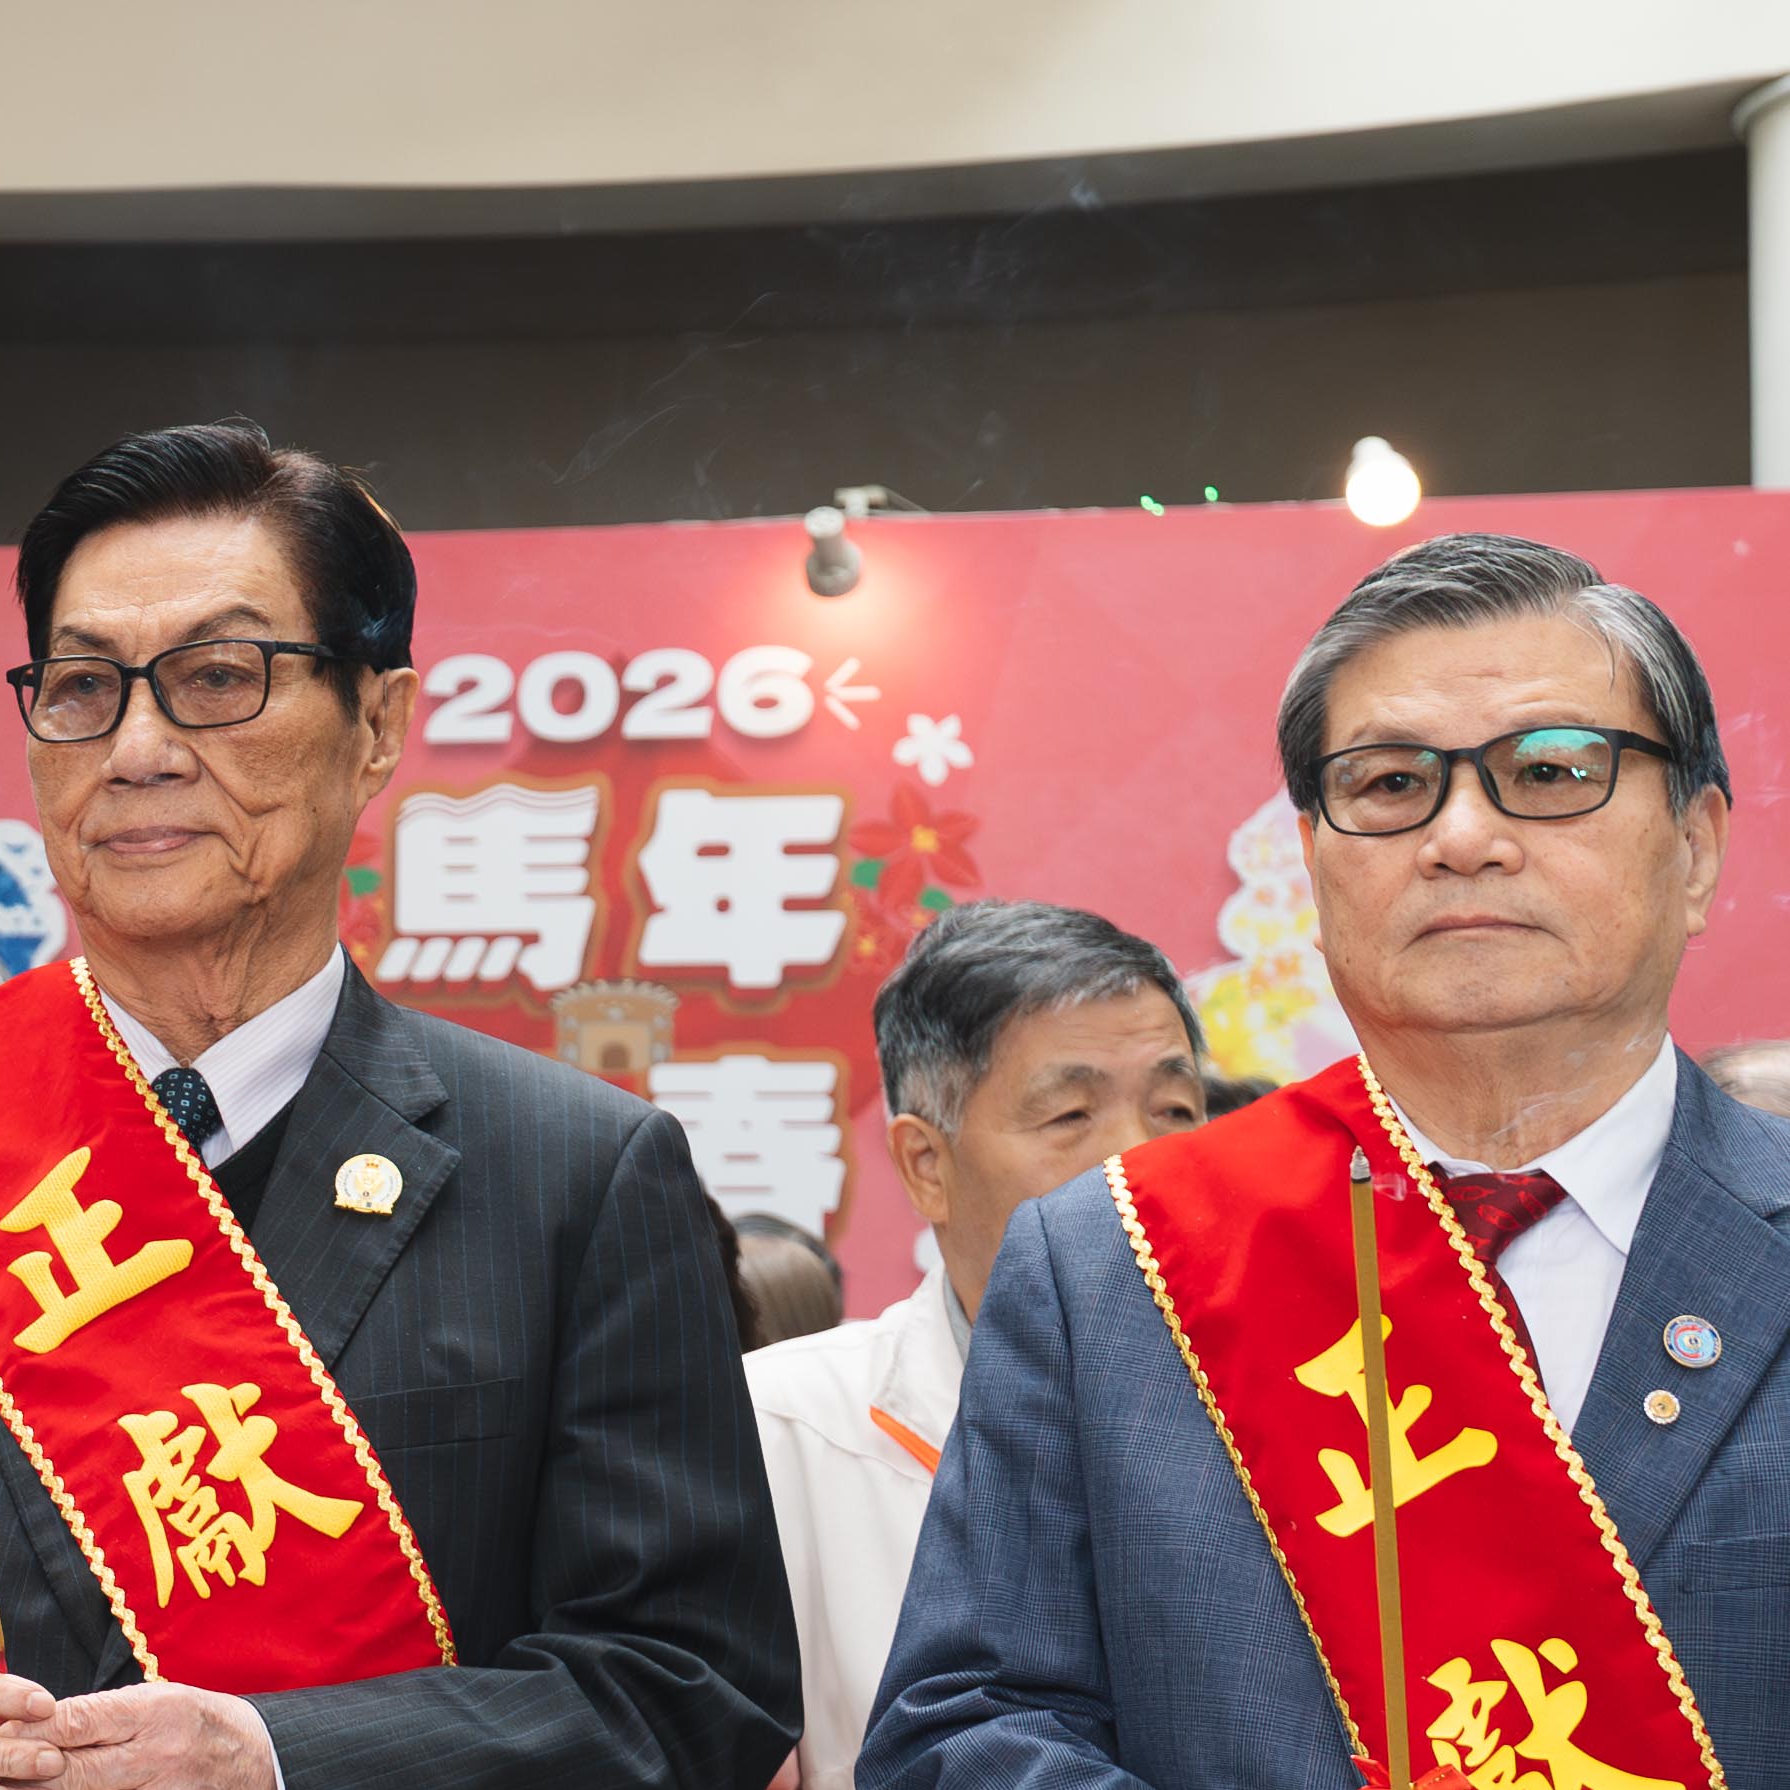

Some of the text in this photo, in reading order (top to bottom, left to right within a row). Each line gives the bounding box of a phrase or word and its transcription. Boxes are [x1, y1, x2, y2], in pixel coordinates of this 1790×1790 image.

[422, 645, 816, 745] 2026
[375, 783, 847, 990] 馬年
[647, 1054, 847, 1240] 春
